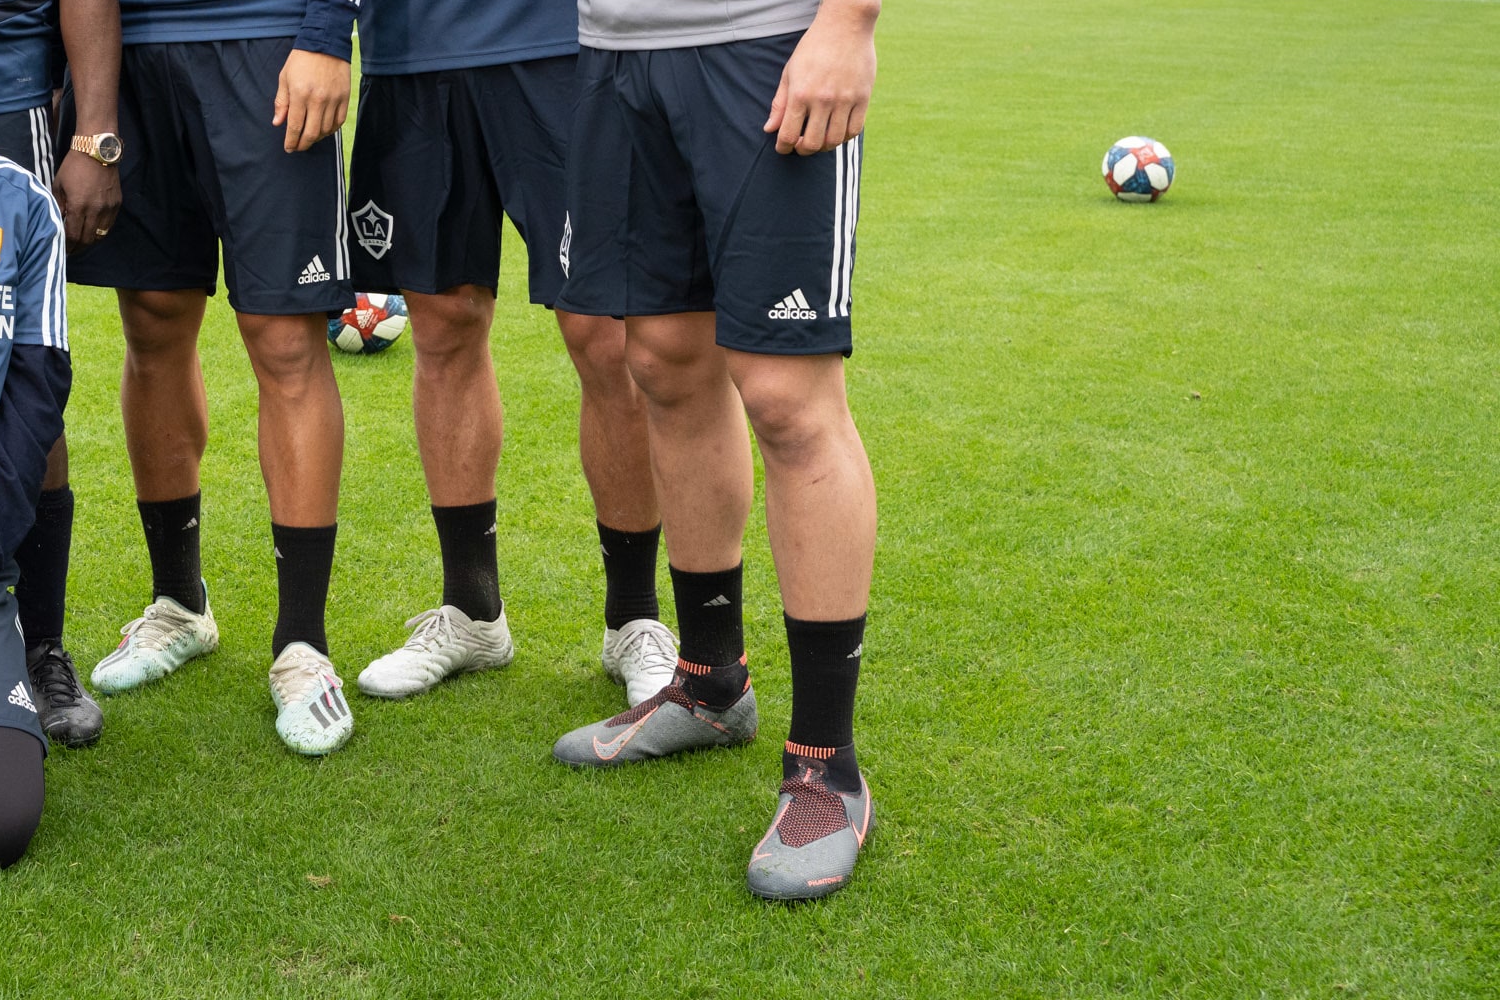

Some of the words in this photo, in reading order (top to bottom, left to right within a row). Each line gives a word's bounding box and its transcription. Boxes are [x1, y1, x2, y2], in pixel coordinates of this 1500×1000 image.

[363, 221, 386, 238] LA
[298, 270, 330, 285] adidas
[767, 307, 818, 321] adidas
